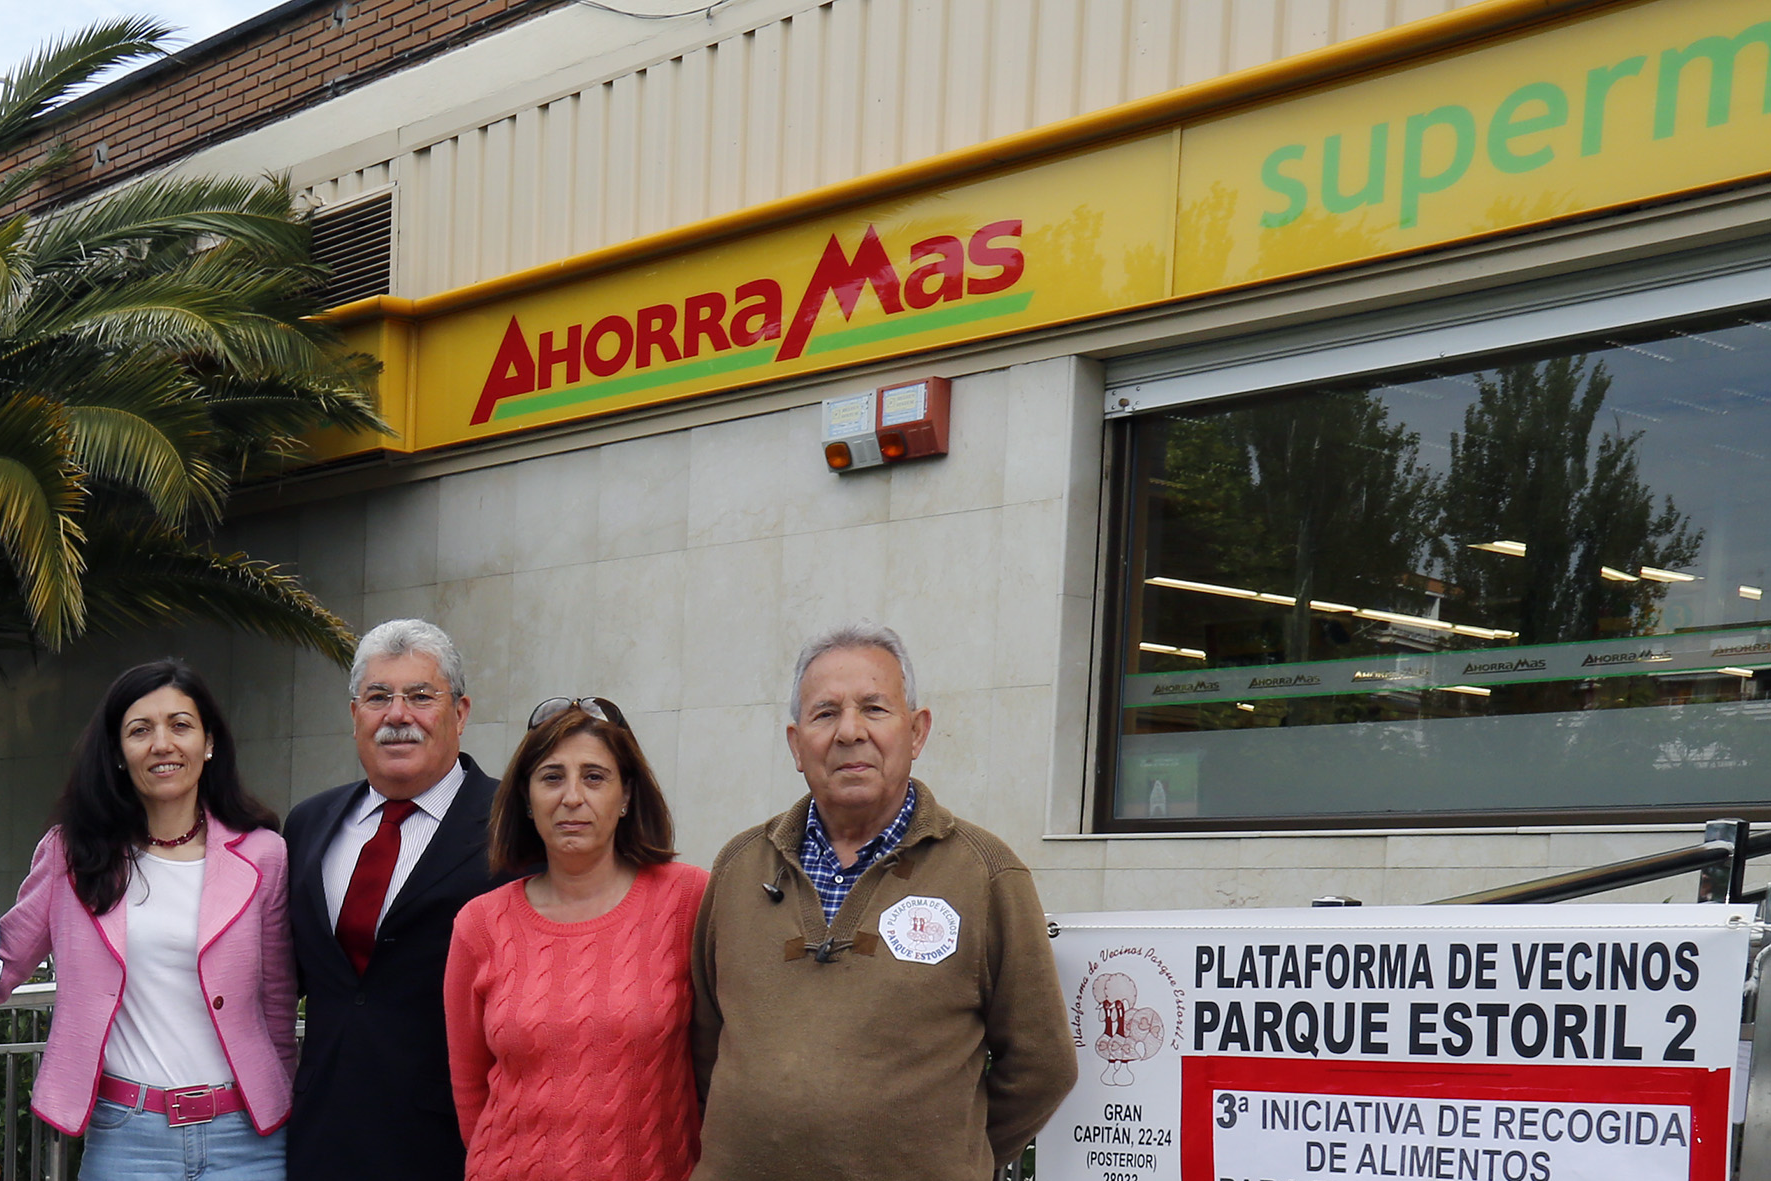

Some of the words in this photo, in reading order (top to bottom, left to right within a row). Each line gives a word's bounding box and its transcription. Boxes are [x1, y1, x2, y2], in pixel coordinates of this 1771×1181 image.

[887, 899, 928, 926] PLATAFORMA
[929, 900, 940, 910] DE
[939, 904, 957, 936] VECINOS
[887, 929, 914, 958] PARQUE
[914, 943, 951, 961] ESTORIL
[1195, 943, 1434, 990] PLATAFORMA
[1447, 943, 1498, 990] DE
[1512, 941, 1700, 991] VECINOS
[1100, 946, 1143, 962] Vecinos
[1144, 947, 1177, 987] Parque
[1173, 989, 1186, 1040] Estoril
[1193, 1001, 1390, 1058] PARQUE
[1409, 1002, 1643, 1060] ESTORIL
[1662, 1004, 1697, 1061] 2
[1104, 1103, 1142, 1122] GRAN
[1261, 1099, 1425, 1135] INICIATIVA
[1437, 1105, 1482, 1138] DE
[1493, 1107, 1688, 1147] RECOGIDA
[1074, 1123, 1134, 1148] CAPITÁN,
[1138, 1128, 1172, 1146] 22-24
[1086, 1151, 1157, 1172] (POSTERIOR)
[1305, 1141, 1348, 1173] DE
